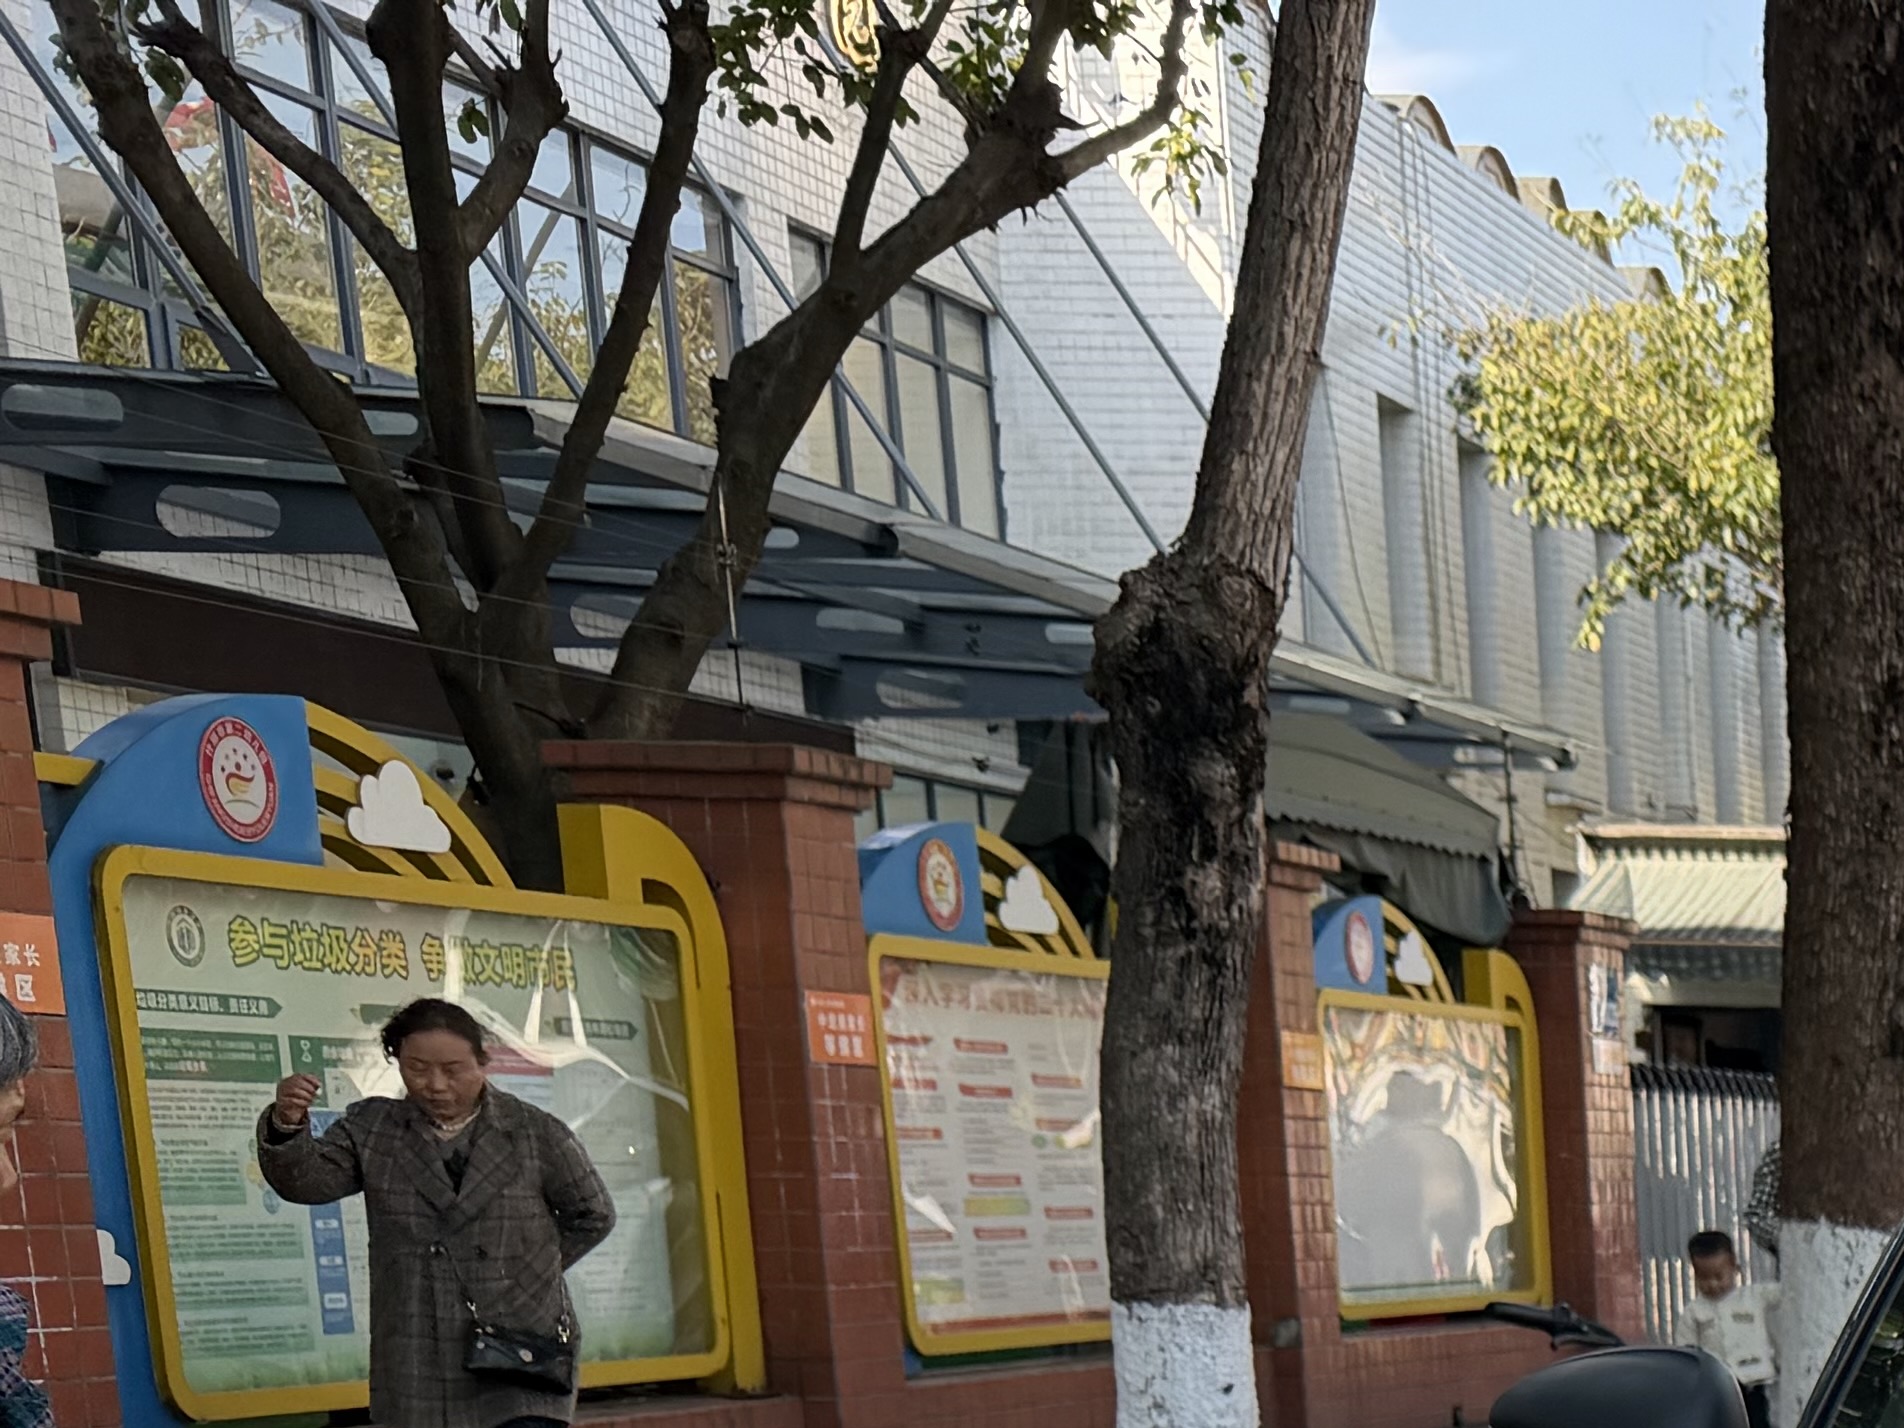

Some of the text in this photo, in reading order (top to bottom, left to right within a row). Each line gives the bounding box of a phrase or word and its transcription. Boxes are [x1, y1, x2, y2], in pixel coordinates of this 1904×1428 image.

[228, 913, 409, 980] 参与垃圾分类
